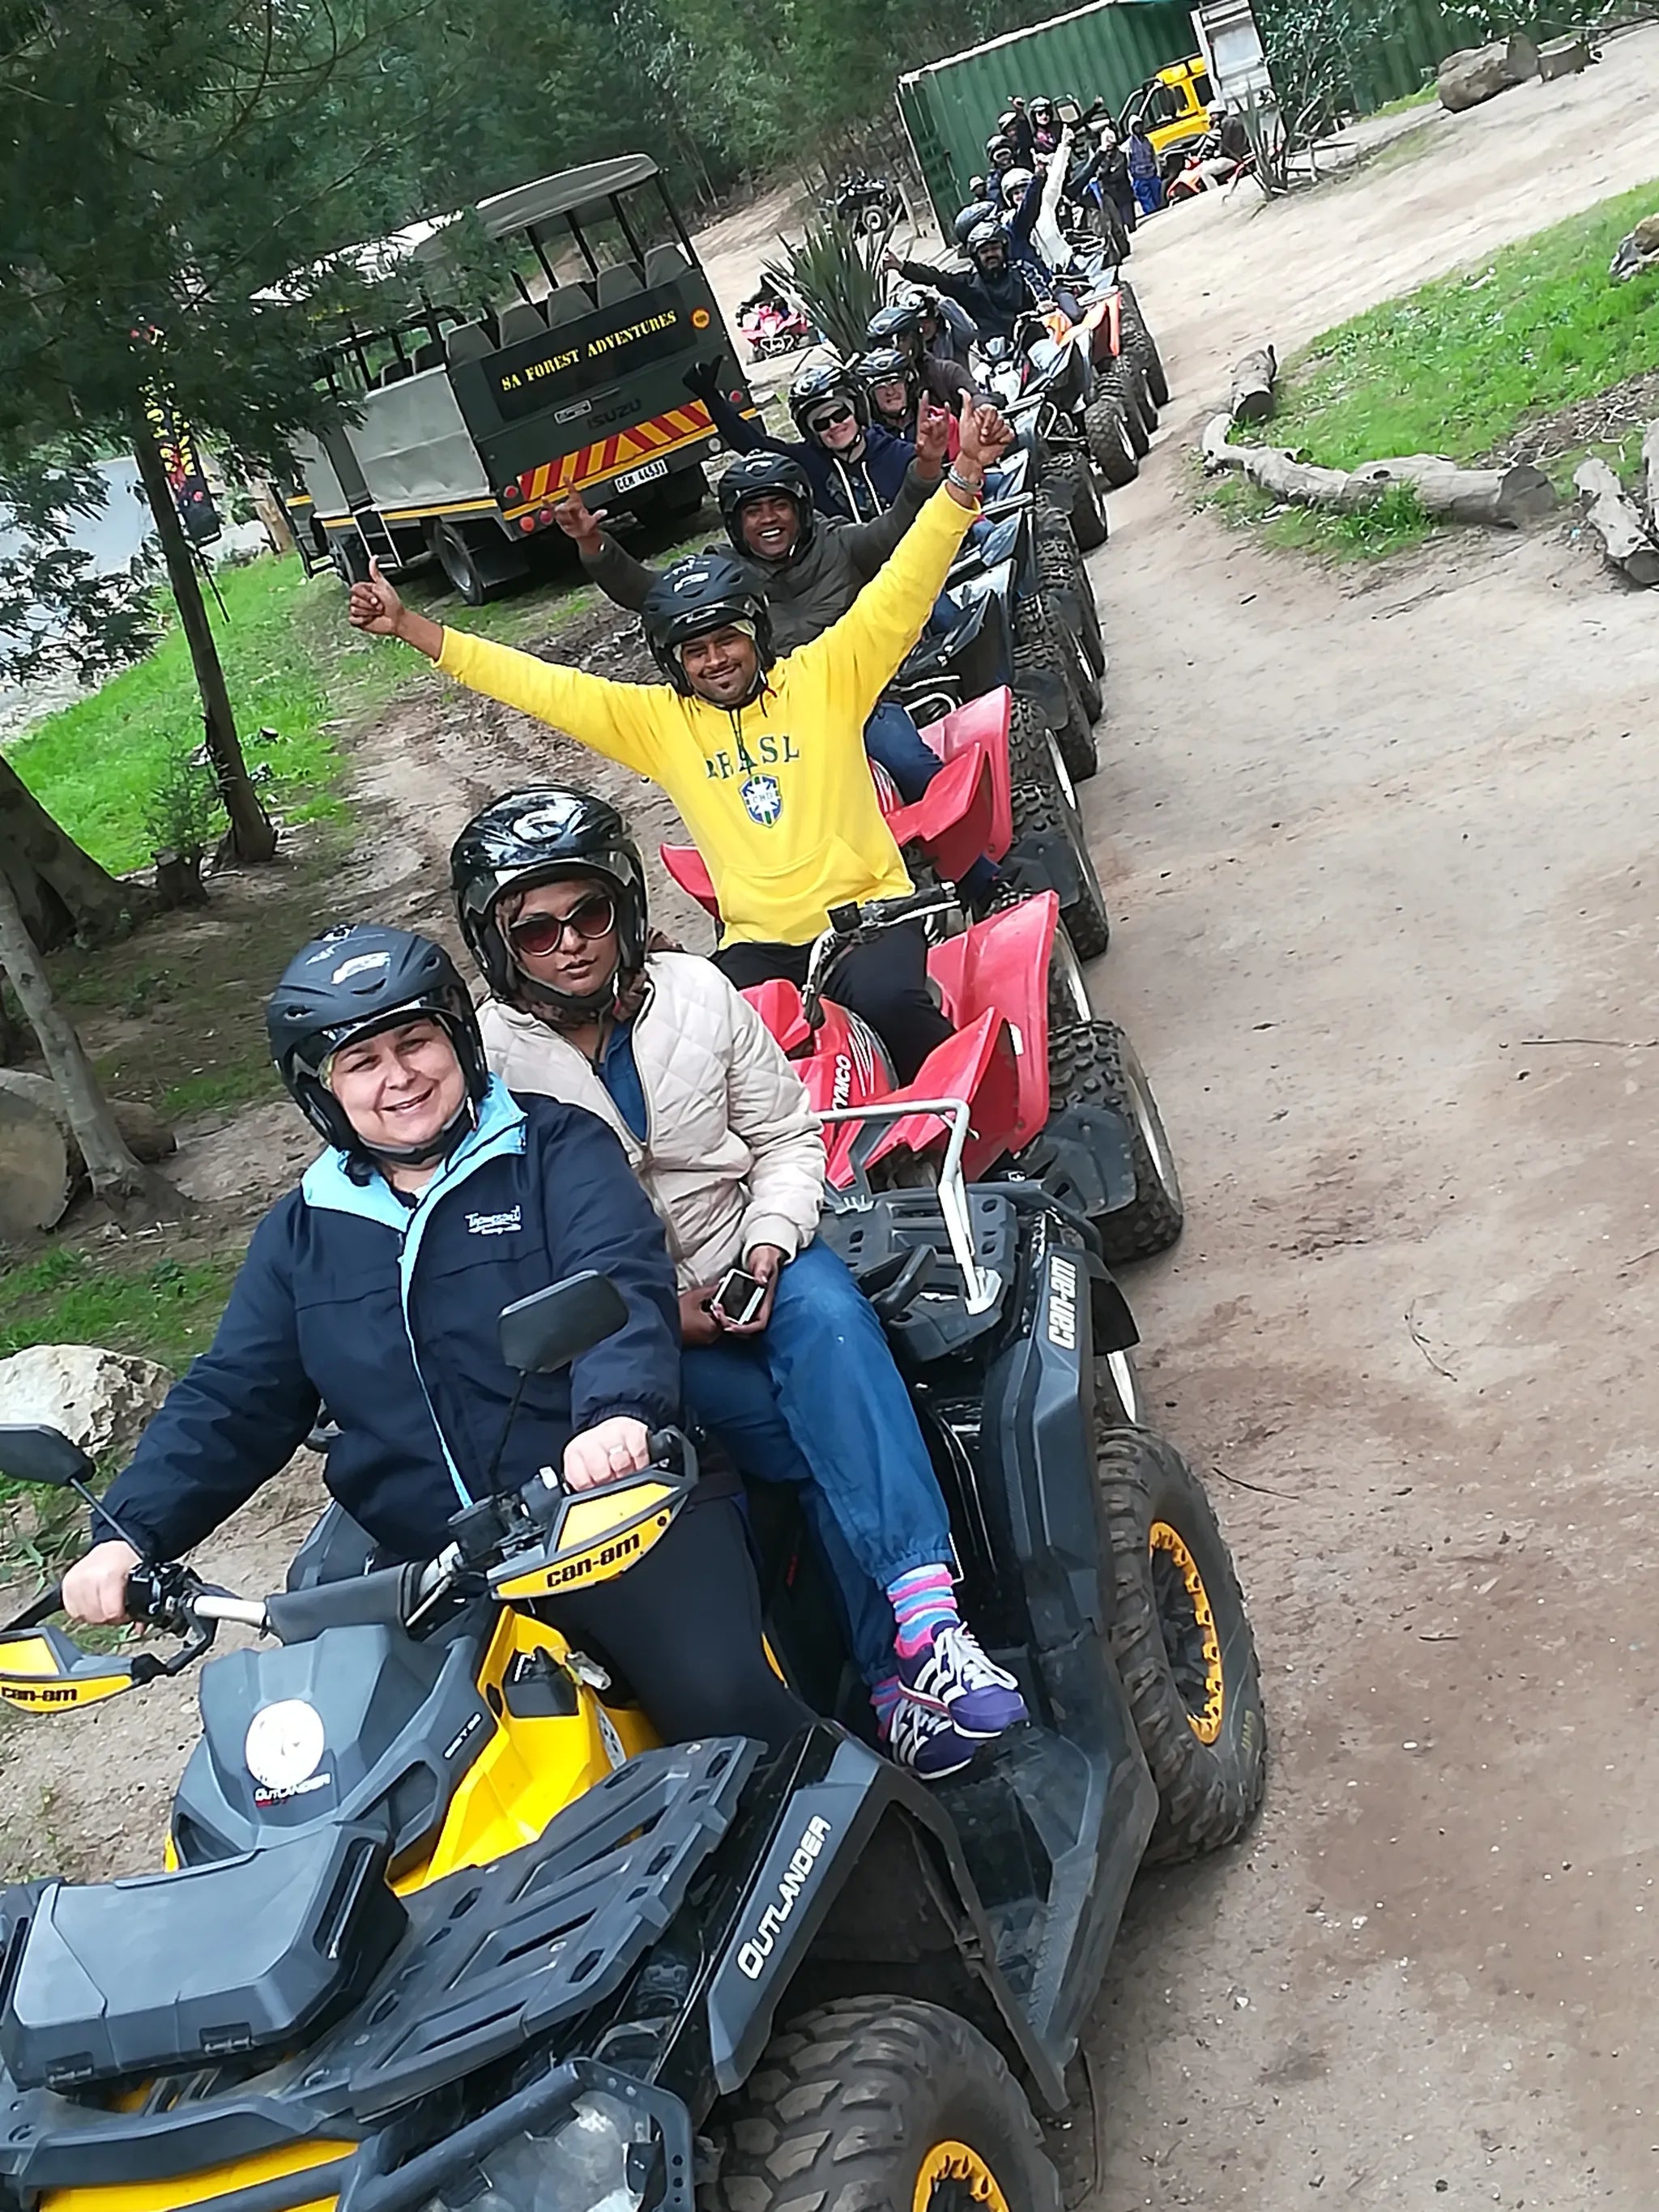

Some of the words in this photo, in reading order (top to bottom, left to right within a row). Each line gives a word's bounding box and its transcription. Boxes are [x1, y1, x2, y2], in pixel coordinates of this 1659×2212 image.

[501, 373, 522, 391] SA
[525, 349, 580, 381] FOREST
[587, 310, 677, 357] ADVENTURES
[587, 399, 642, 430] ISUZU
[1048, 1255, 1076, 1350] can-am
[546, 1533, 640, 1588] can-am
[737, 1815, 832, 1980] OUTLANDER
